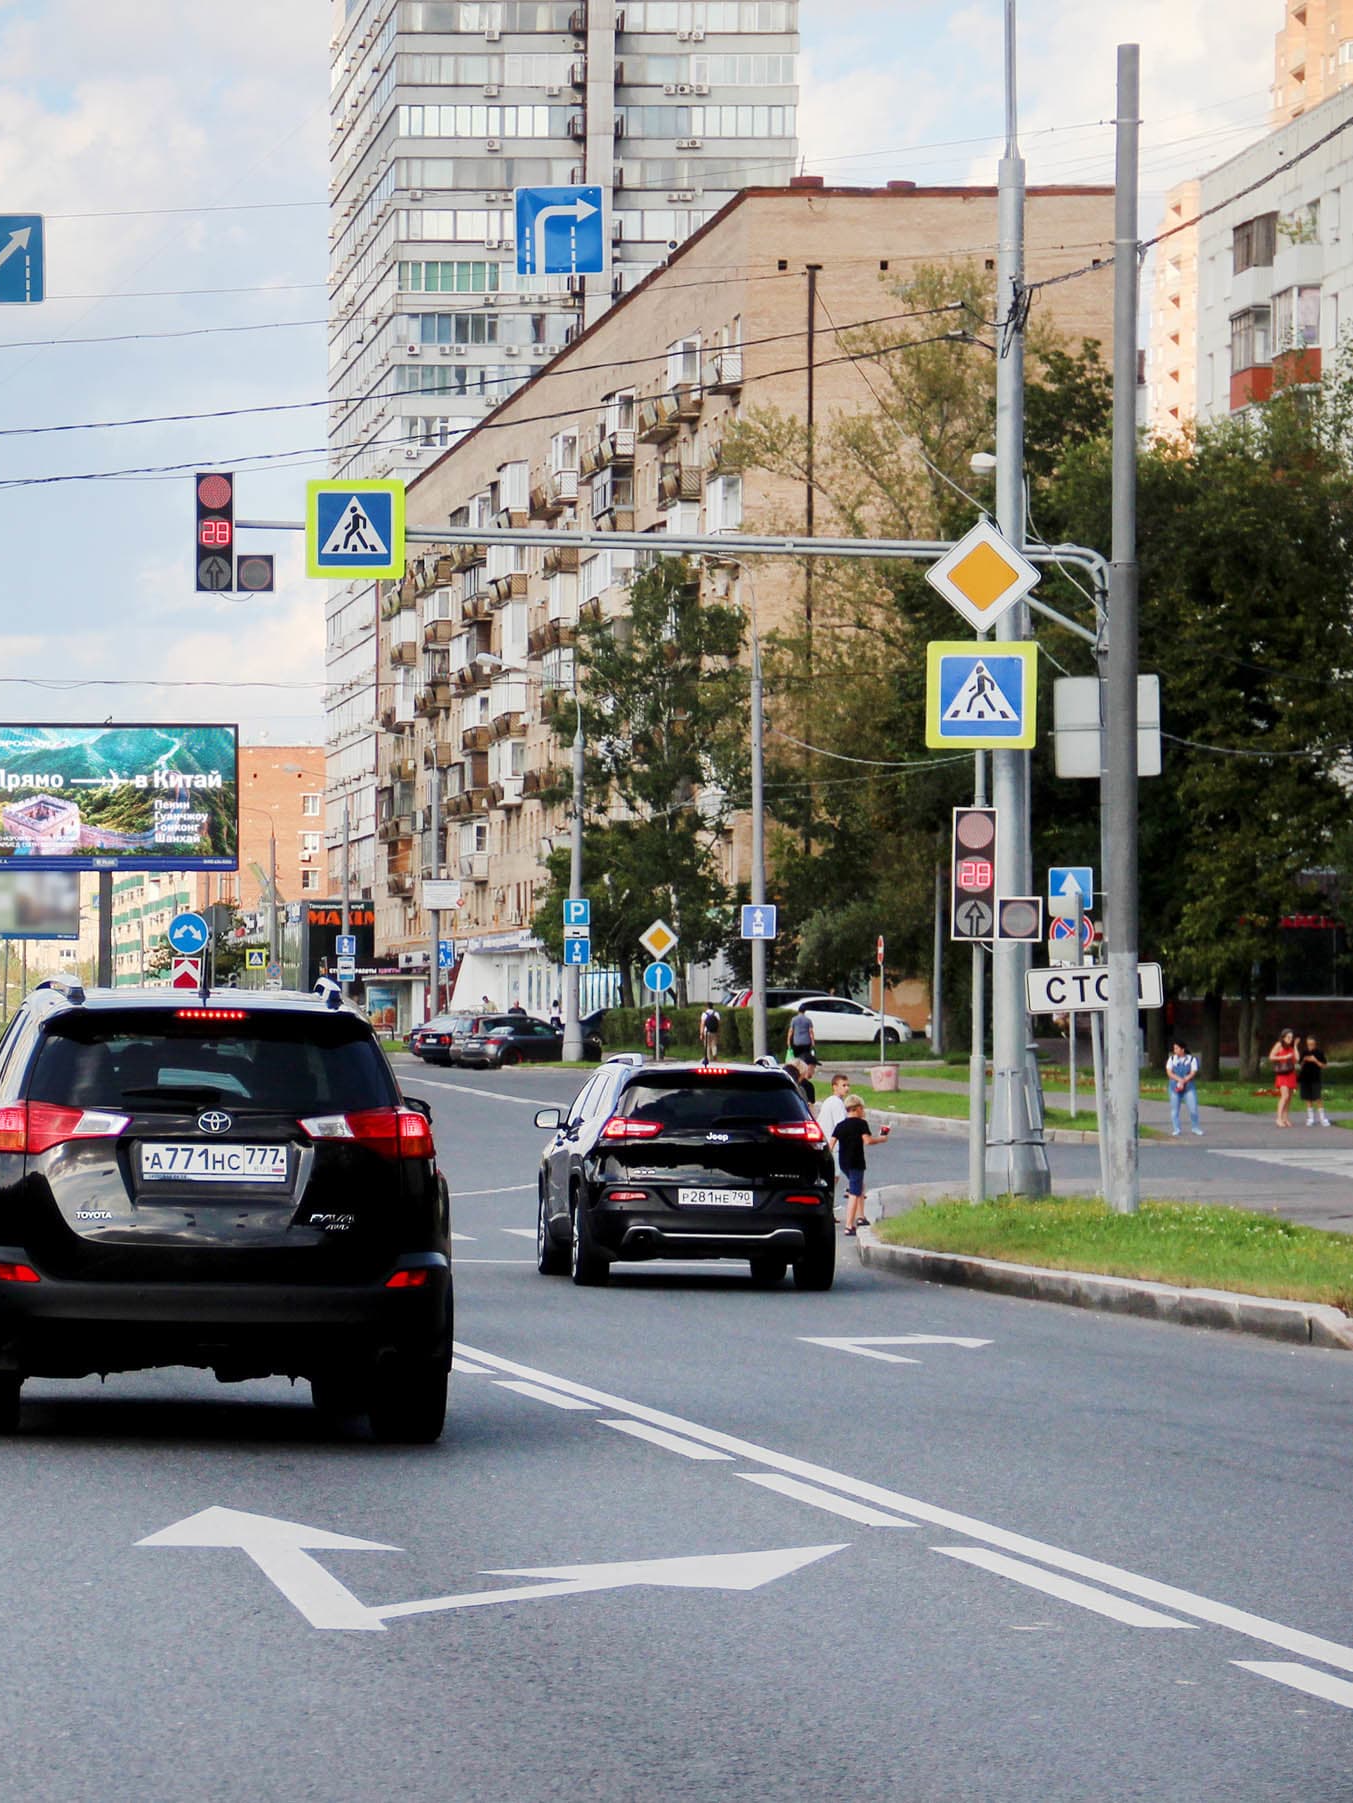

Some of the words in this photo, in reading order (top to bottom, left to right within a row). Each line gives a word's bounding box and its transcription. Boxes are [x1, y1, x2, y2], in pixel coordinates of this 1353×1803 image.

[202, 521, 229, 543] 28
[135, 775, 147, 788] в
[153, 770, 223, 788] Китай
[154, 800, 190, 809] Пекин
[154, 811, 209, 823] Гуанчжоу
[154, 822, 200, 832] Гонконг
[154, 832, 201, 843] Шанхай
[961, 862, 991, 886] 28
[570, 902, 585, 923] P
[706, 1132, 729, 1142] Jeep
[150, 1148, 241, 1171] А771НС
[246, 1148, 280, 1165] 777
[682, 1191, 729, 1203] Р281НЕ
[732, 1191, 750, 1201] 790
[76, 1211, 112, 1220] TOYOTA
